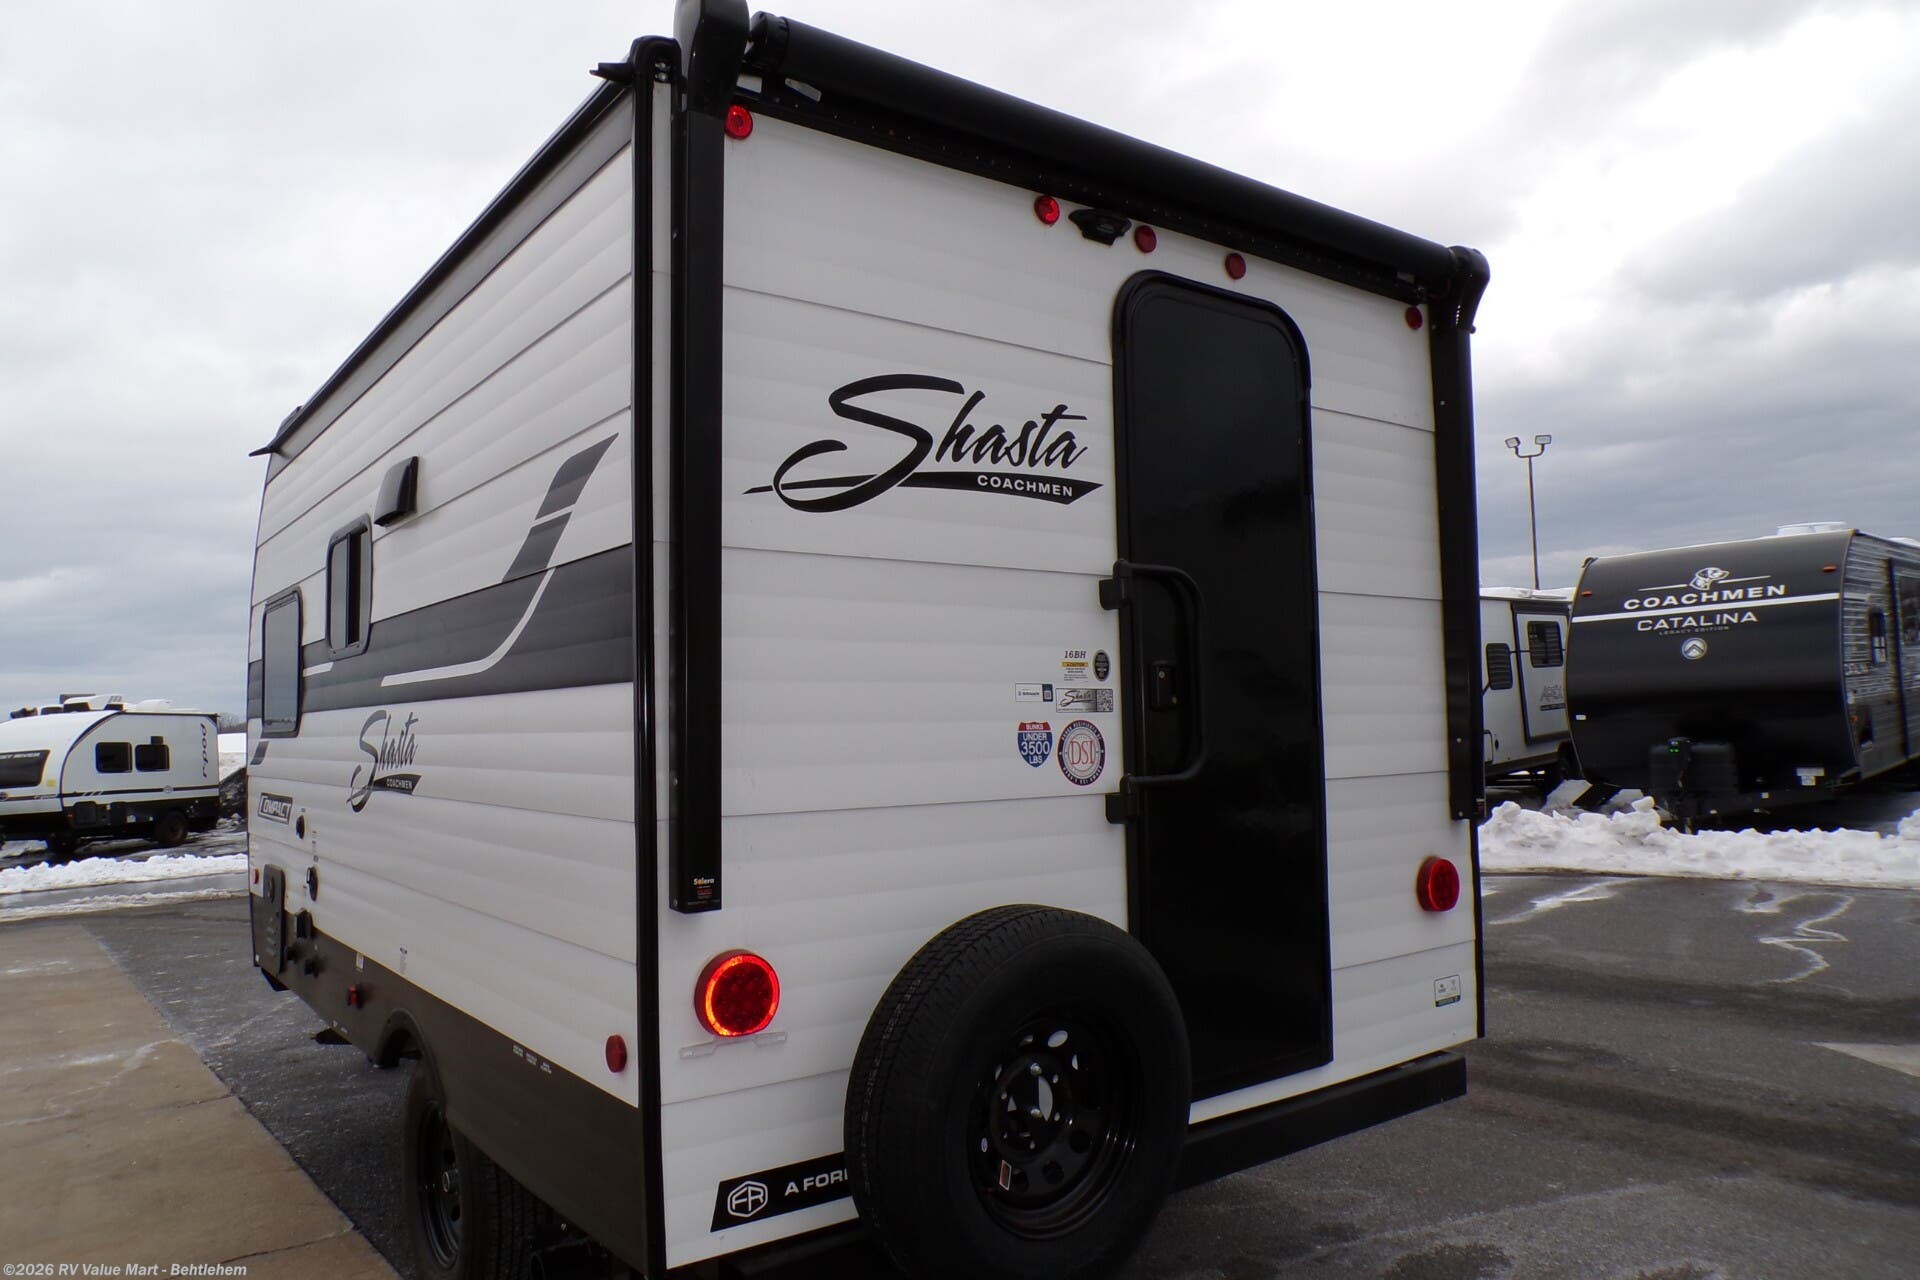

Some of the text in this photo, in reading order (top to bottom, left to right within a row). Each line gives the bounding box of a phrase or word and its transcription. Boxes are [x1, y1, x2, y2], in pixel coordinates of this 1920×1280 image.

[773, 373, 1089, 513] Shasta
[977, 473, 1074, 497] COACHMEN
[1623, 584, 1786, 610] COACHMEN
[1637, 610, 1758, 632] CATALINA
[1064, 650, 1087, 659] 16BH
[1021, 741, 1050, 755] 3500
[1022, 732, 1047, 741] UNDER
[350, 709, 419, 813] Shasta
[1029, 755, 1043, 764] LBS
[1070, 740, 1094, 765] DSI
[784, 1168, 848, 1196] A FOR
